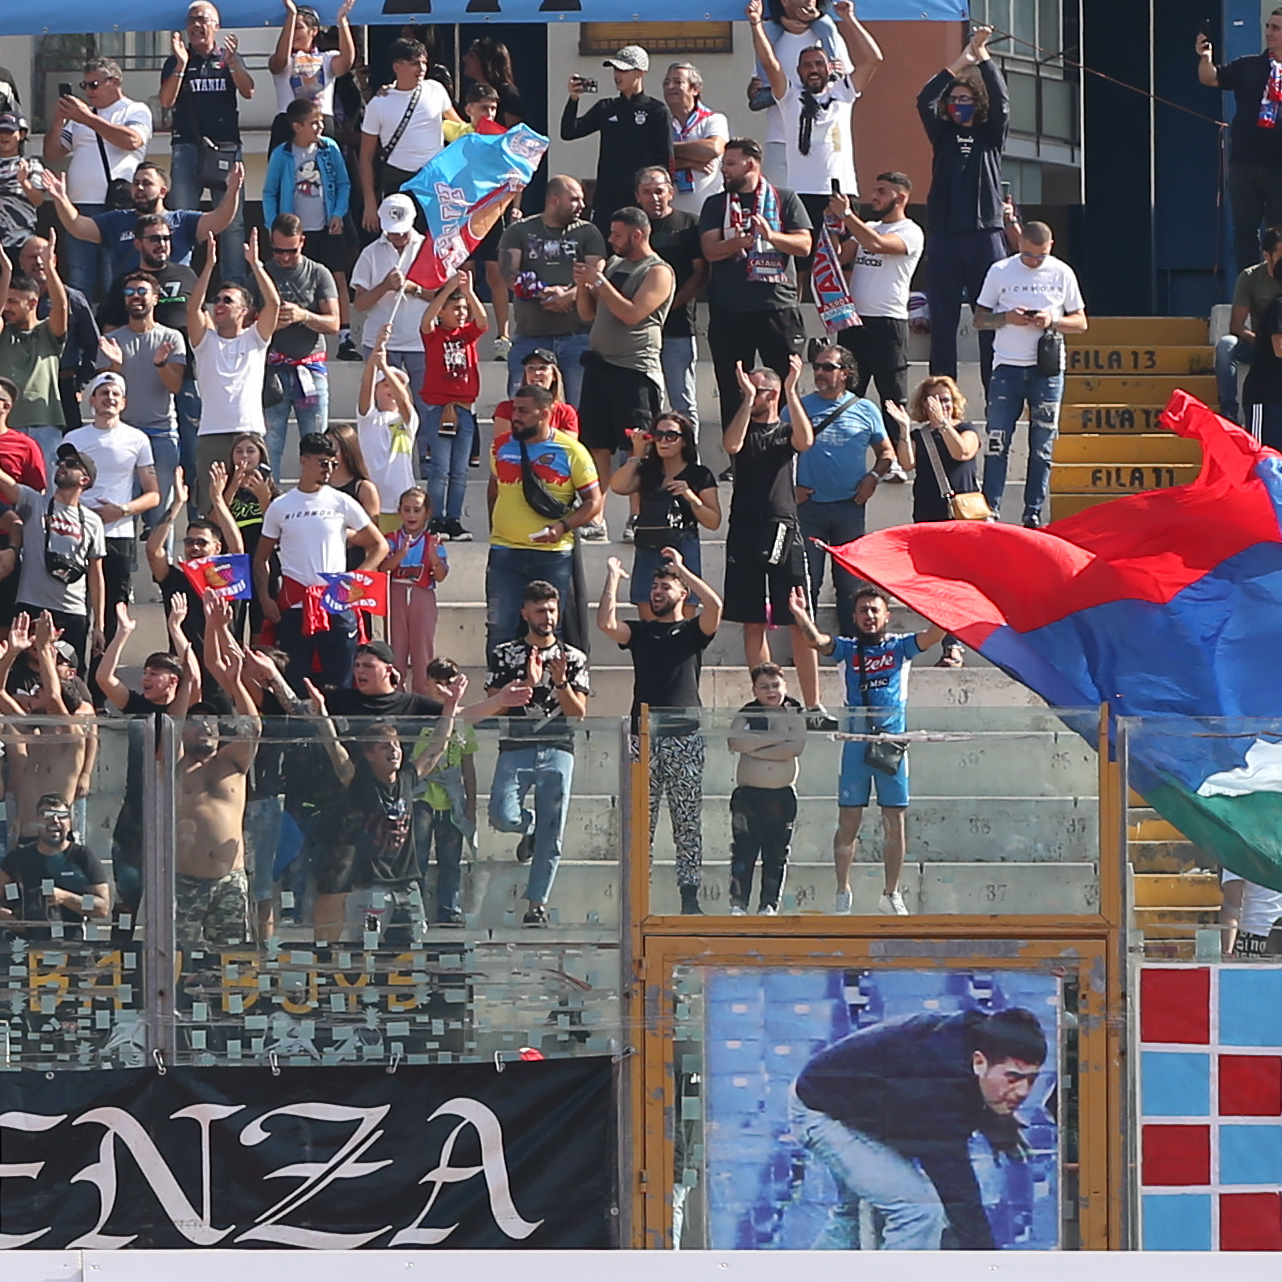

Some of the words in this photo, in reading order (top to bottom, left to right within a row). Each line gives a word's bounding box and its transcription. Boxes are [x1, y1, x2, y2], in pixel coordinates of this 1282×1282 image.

[1070, 350, 1122, 371] FILA
[1132, 350, 1157, 371] 13
[1081, 408, 1134, 429] FILA
[1091, 468, 1144, 489] FILA
[1152, 468, 1176, 488] 11
